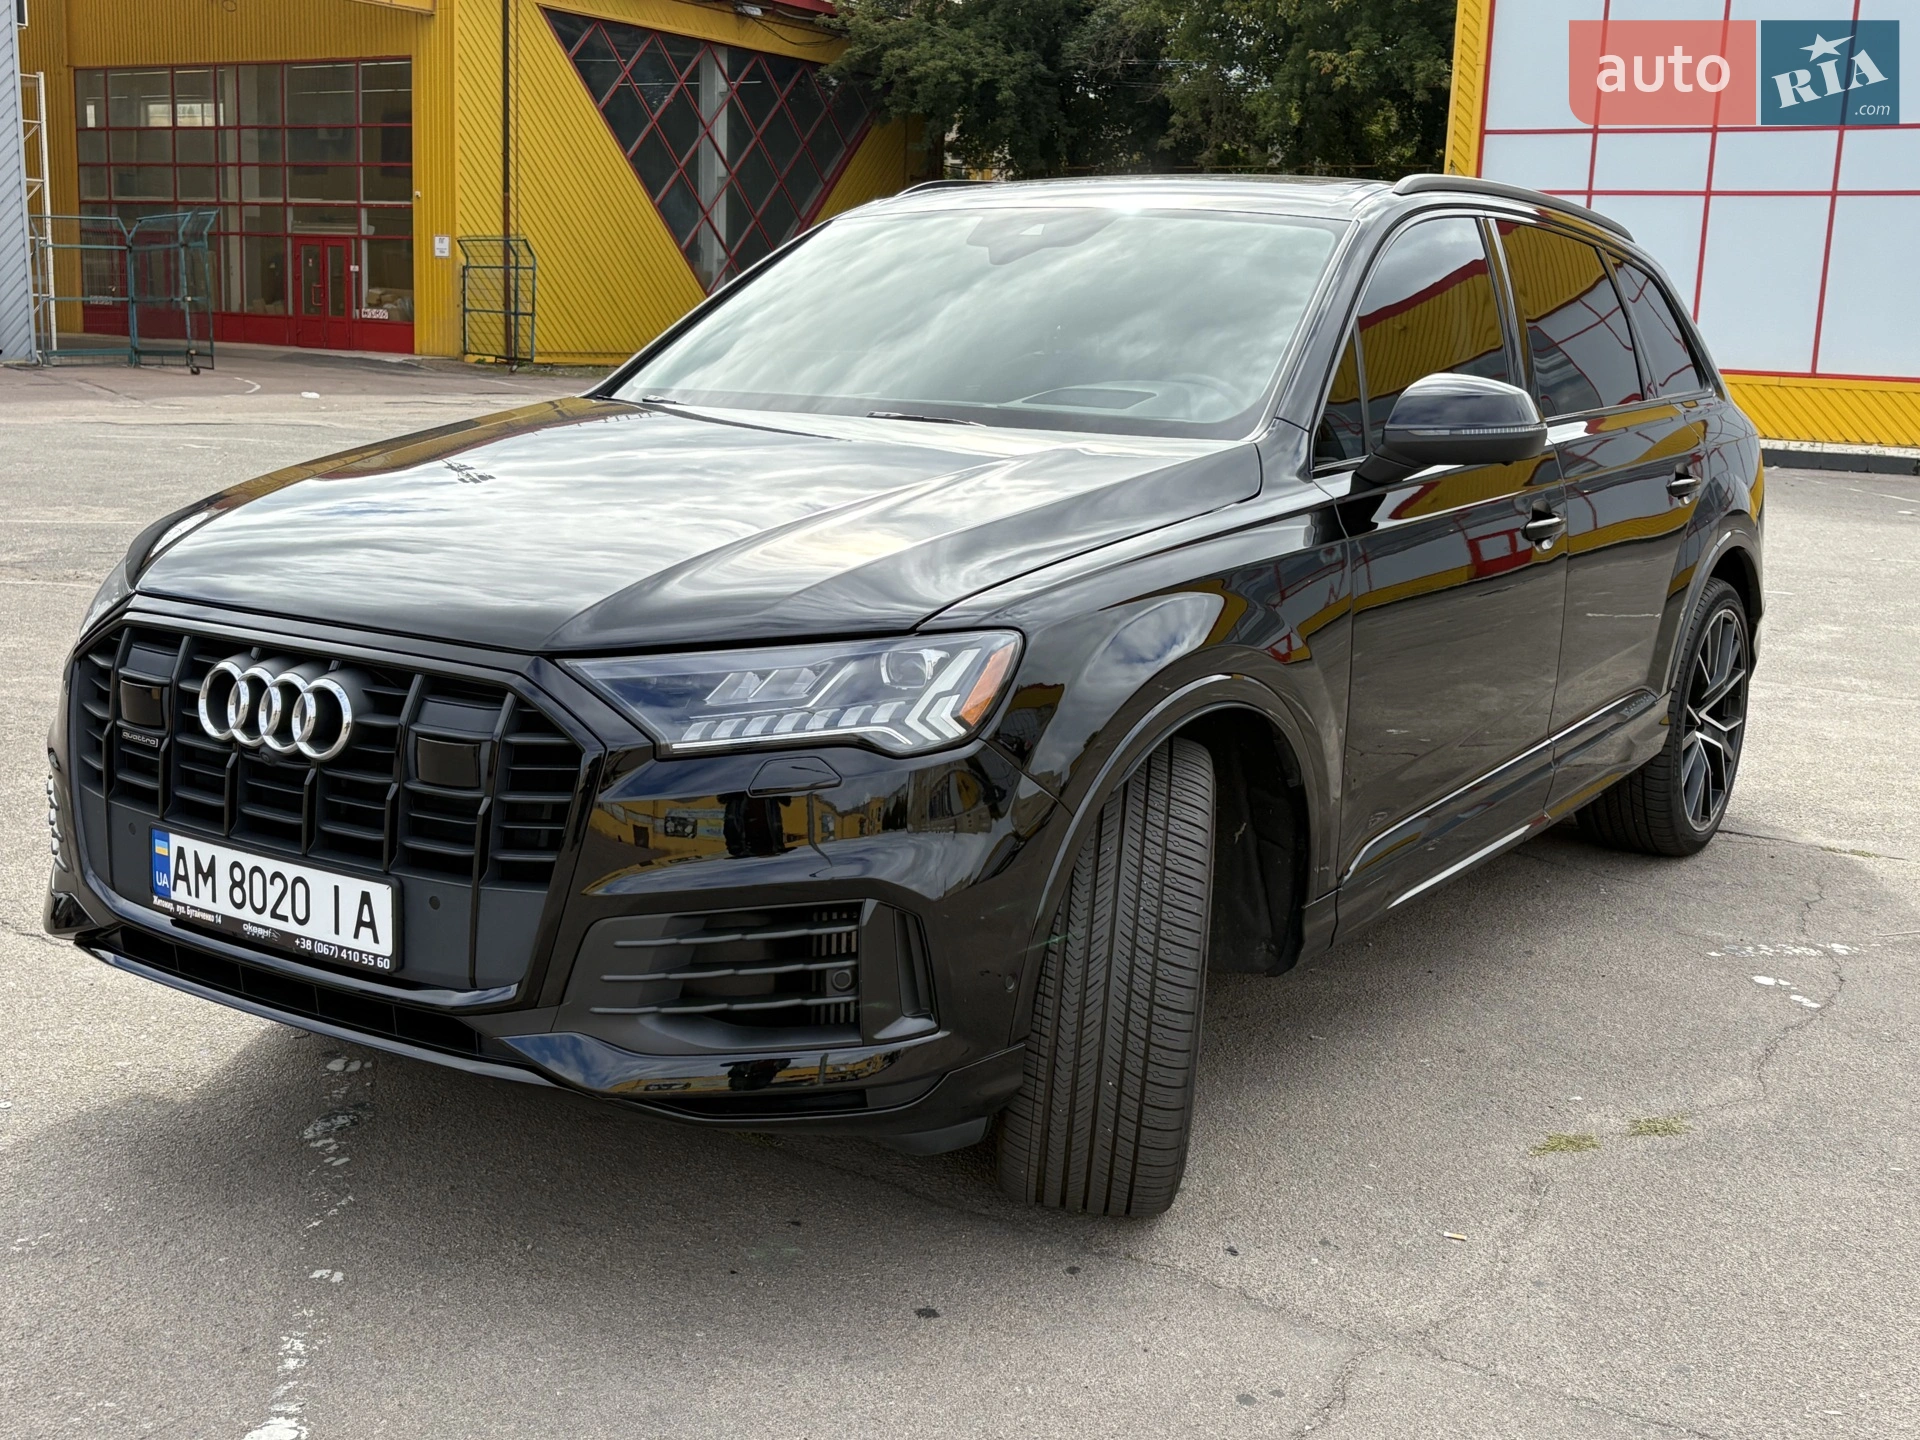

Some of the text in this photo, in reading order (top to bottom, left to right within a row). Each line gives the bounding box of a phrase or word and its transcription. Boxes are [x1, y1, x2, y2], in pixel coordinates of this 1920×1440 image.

[156, 871, 170, 889] UA
[172, 846, 217, 904] AM
[228, 860, 311, 926] 8020
[294, 937, 390, 970] +38 (067) 410 55 60
